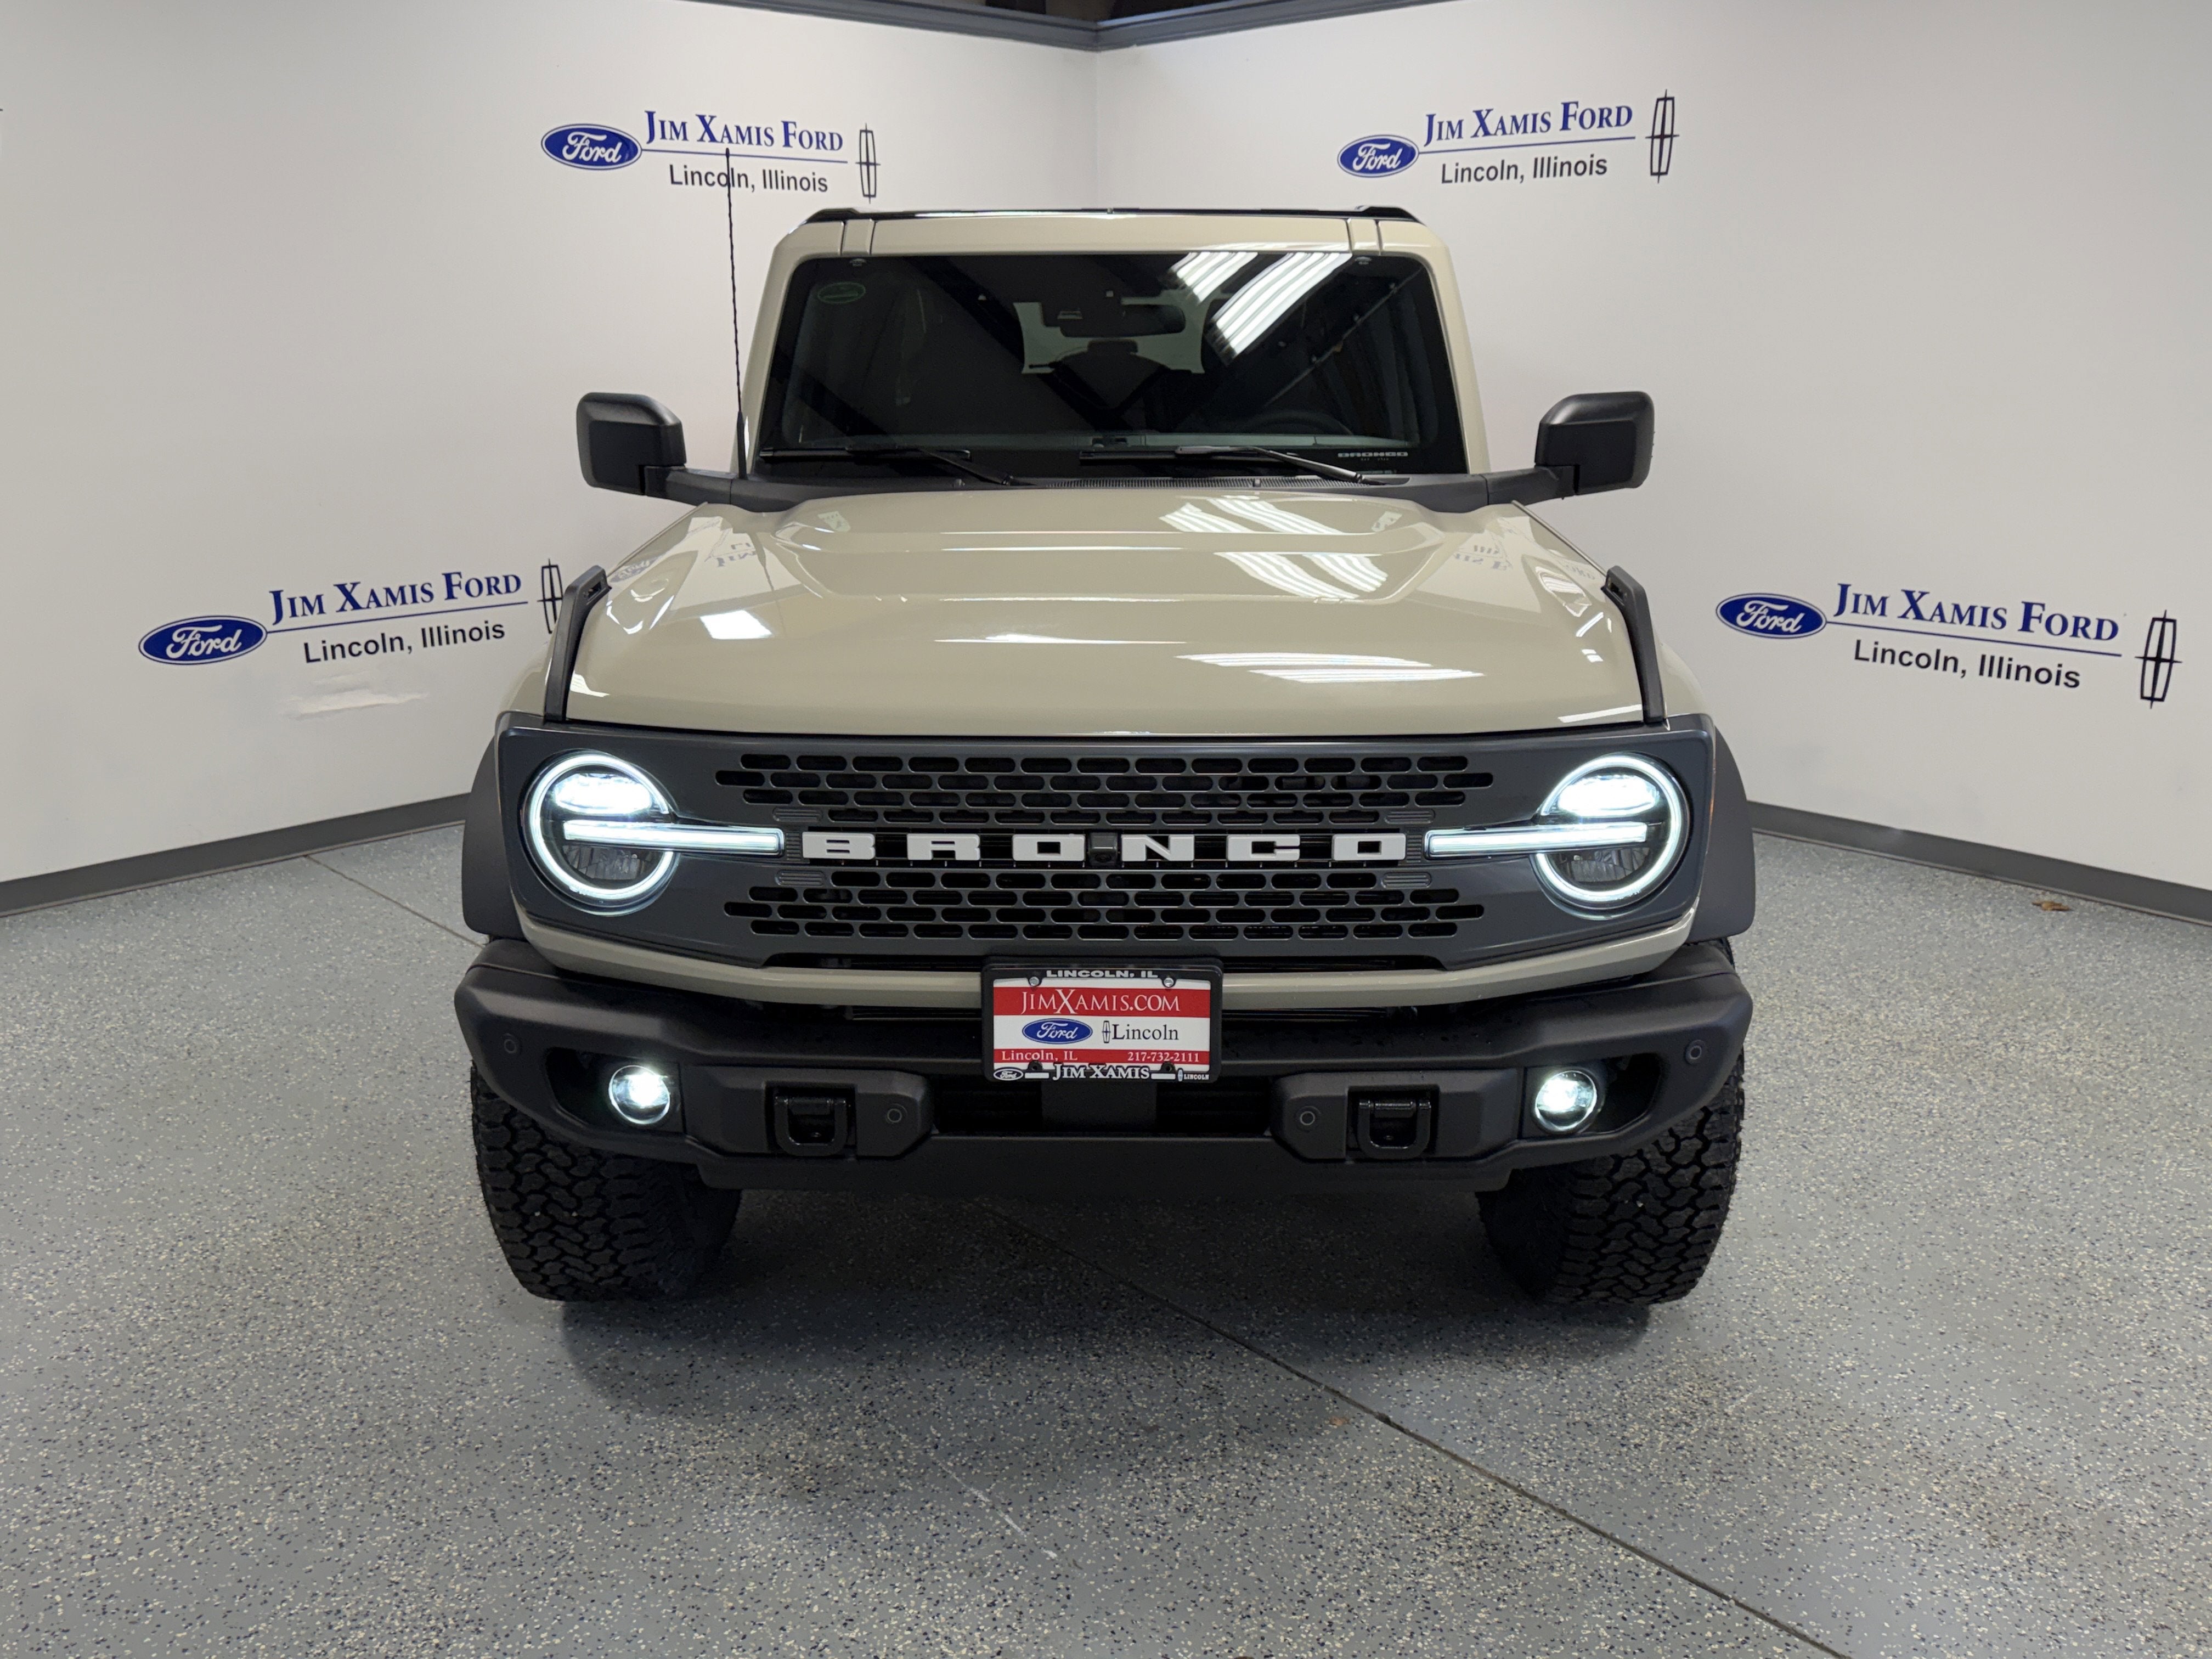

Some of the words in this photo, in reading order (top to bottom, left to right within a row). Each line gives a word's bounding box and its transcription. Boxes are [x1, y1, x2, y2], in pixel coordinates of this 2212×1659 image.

[645, 110, 689, 144] JIM
[695, 114, 775, 147] XAMIS
[781, 120, 843, 151] FORD
[1424, 113, 1464, 146] JIM
[1471, 108, 1551, 138] XAMIS
[1559, 101, 1633, 132] FORD
[562, 131, 623, 163] Ford
[1352, 143, 1402, 171] Ford
[669, 164, 755, 193] Lincoln,
[763, 168, 828, 193] Illinois
[1441, 160, 1525, 184] Lincoln,
[1533, 154, 1608, 179] Illinois
[269, 589, 326, 626] JIM
[333, 581, 435, 613] XAMIS
[442, 571, 523, 600] FORD
[1833, 582, 1892, 618] JIM
[1897, 589, 2008, 630] XAMIS
[2017, 600, 2120, 642] FORD
[1736, 600, 1804, 634] Ford
[166, 624, 242, 659] Ford
[303, 635, 413, 664] Lincoln,
[421, 620, 506, 649] Illinois
[1854, 639, 1968, 679] Lincoln,
[1978, 653, 2082, 689] Illinois
[802, 831, 1407, 861] BRONCO
[1141, 970, 1159, 979] IL
[1020, 988, 1181, 1015] JIMXAMIS.COM
[1036, 1022, 1078, 1040] Ford
[1111, 1024, 1180, 1041] Lincoln
[1001, 1049, 1058, 1062] Lincoln,
[1063, 1051, 1078, 1061] IL
[1127, 1051, 1199, 1062] 217-732-2111
[1052, 1064, 1085, 1080] JIM
[1089, 1064, 1150, 1080] XAMIS
